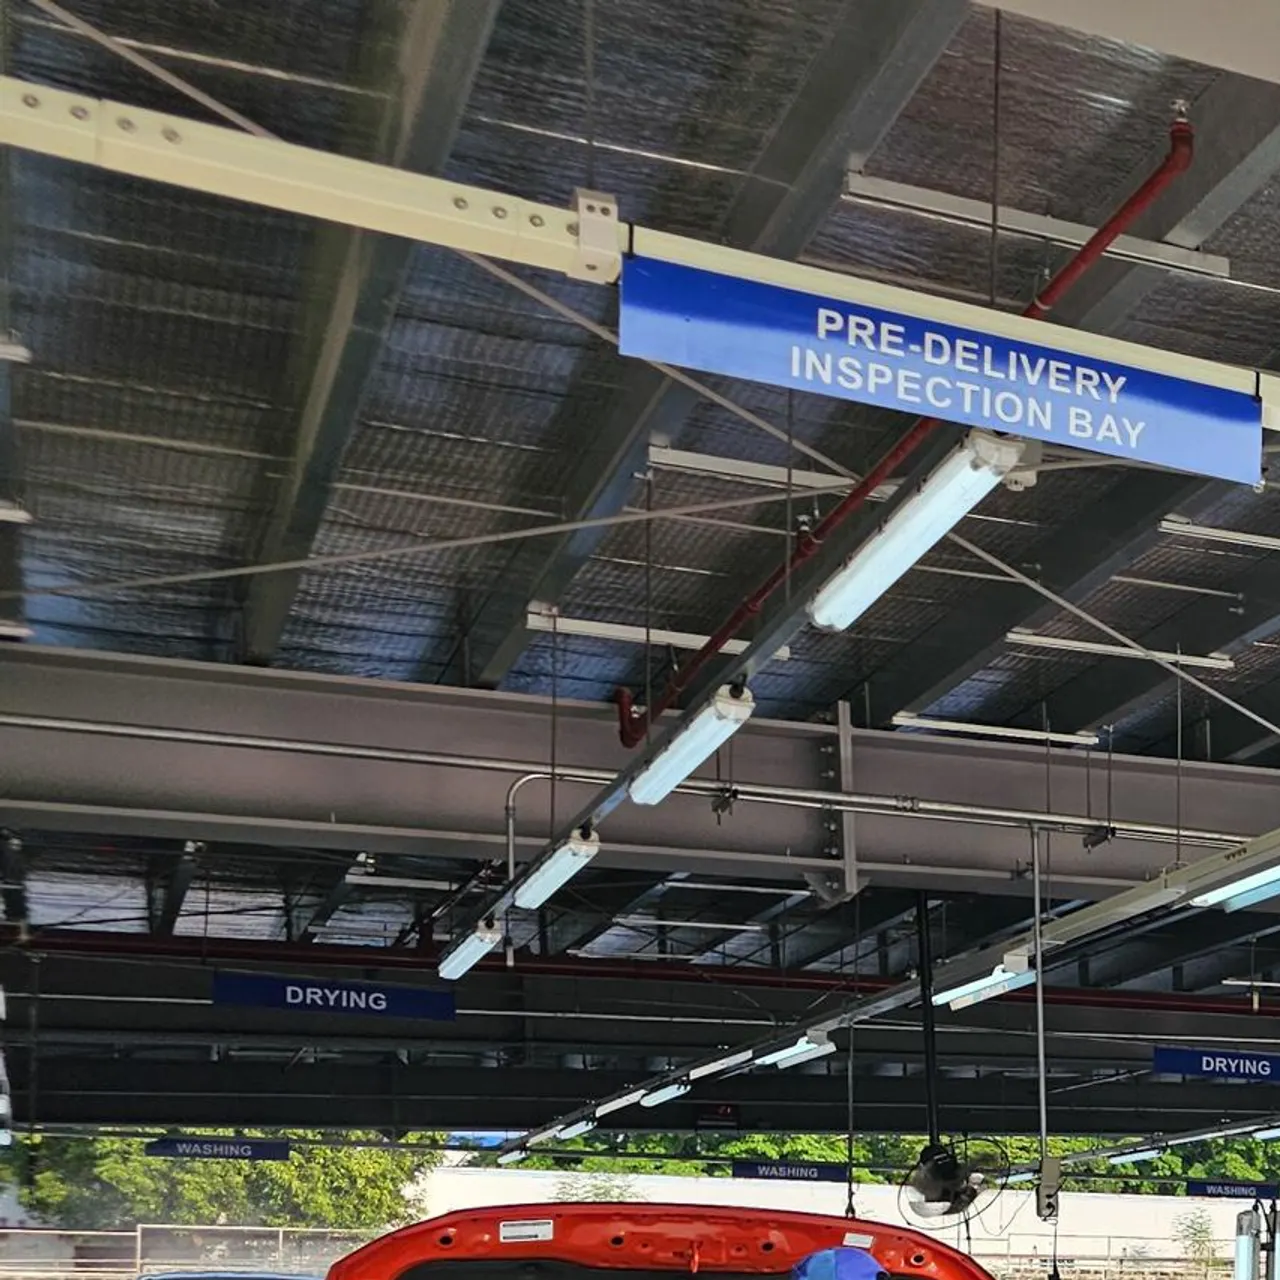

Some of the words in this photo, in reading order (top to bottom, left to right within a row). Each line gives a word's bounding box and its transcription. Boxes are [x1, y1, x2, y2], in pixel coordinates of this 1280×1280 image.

[816, 307, 1128, 405] PRE-DELIVERY
[791, 345, 1053, 431] INSPECTION
[1068, 406, 1146, 449] BAY
[285, 985, 387, 1010] DRYING
[1202, 1056, 1271, 1075] DRYING
[176, 1143, 252, 1157] WASHING
[757, 1164, 819, 1178] WASHING
[1206, 1184, 1257, 1197] WASHING
